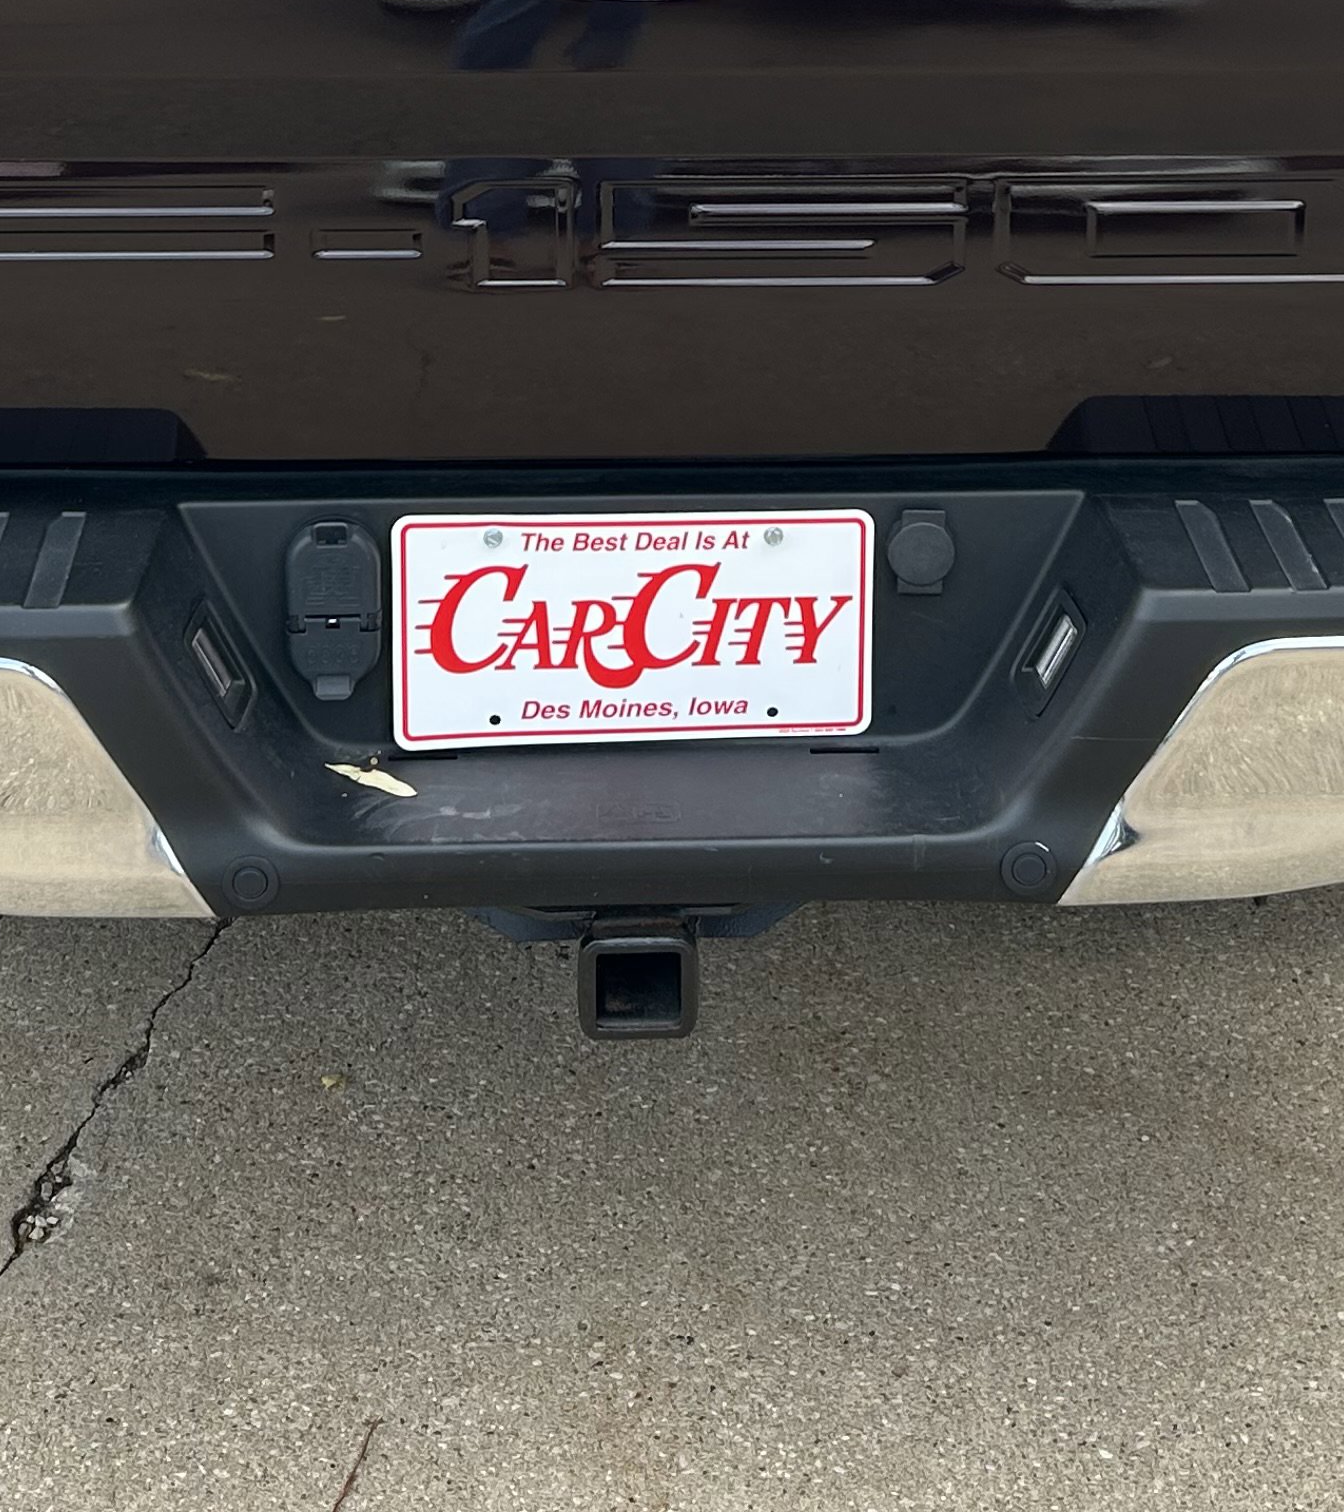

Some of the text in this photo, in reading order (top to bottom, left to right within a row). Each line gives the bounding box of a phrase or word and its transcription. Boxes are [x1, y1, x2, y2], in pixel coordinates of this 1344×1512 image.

[521, 530, 751, 552] The Best Deal Is At
[521, 696, 748, 721] Des Moines, Iowa
